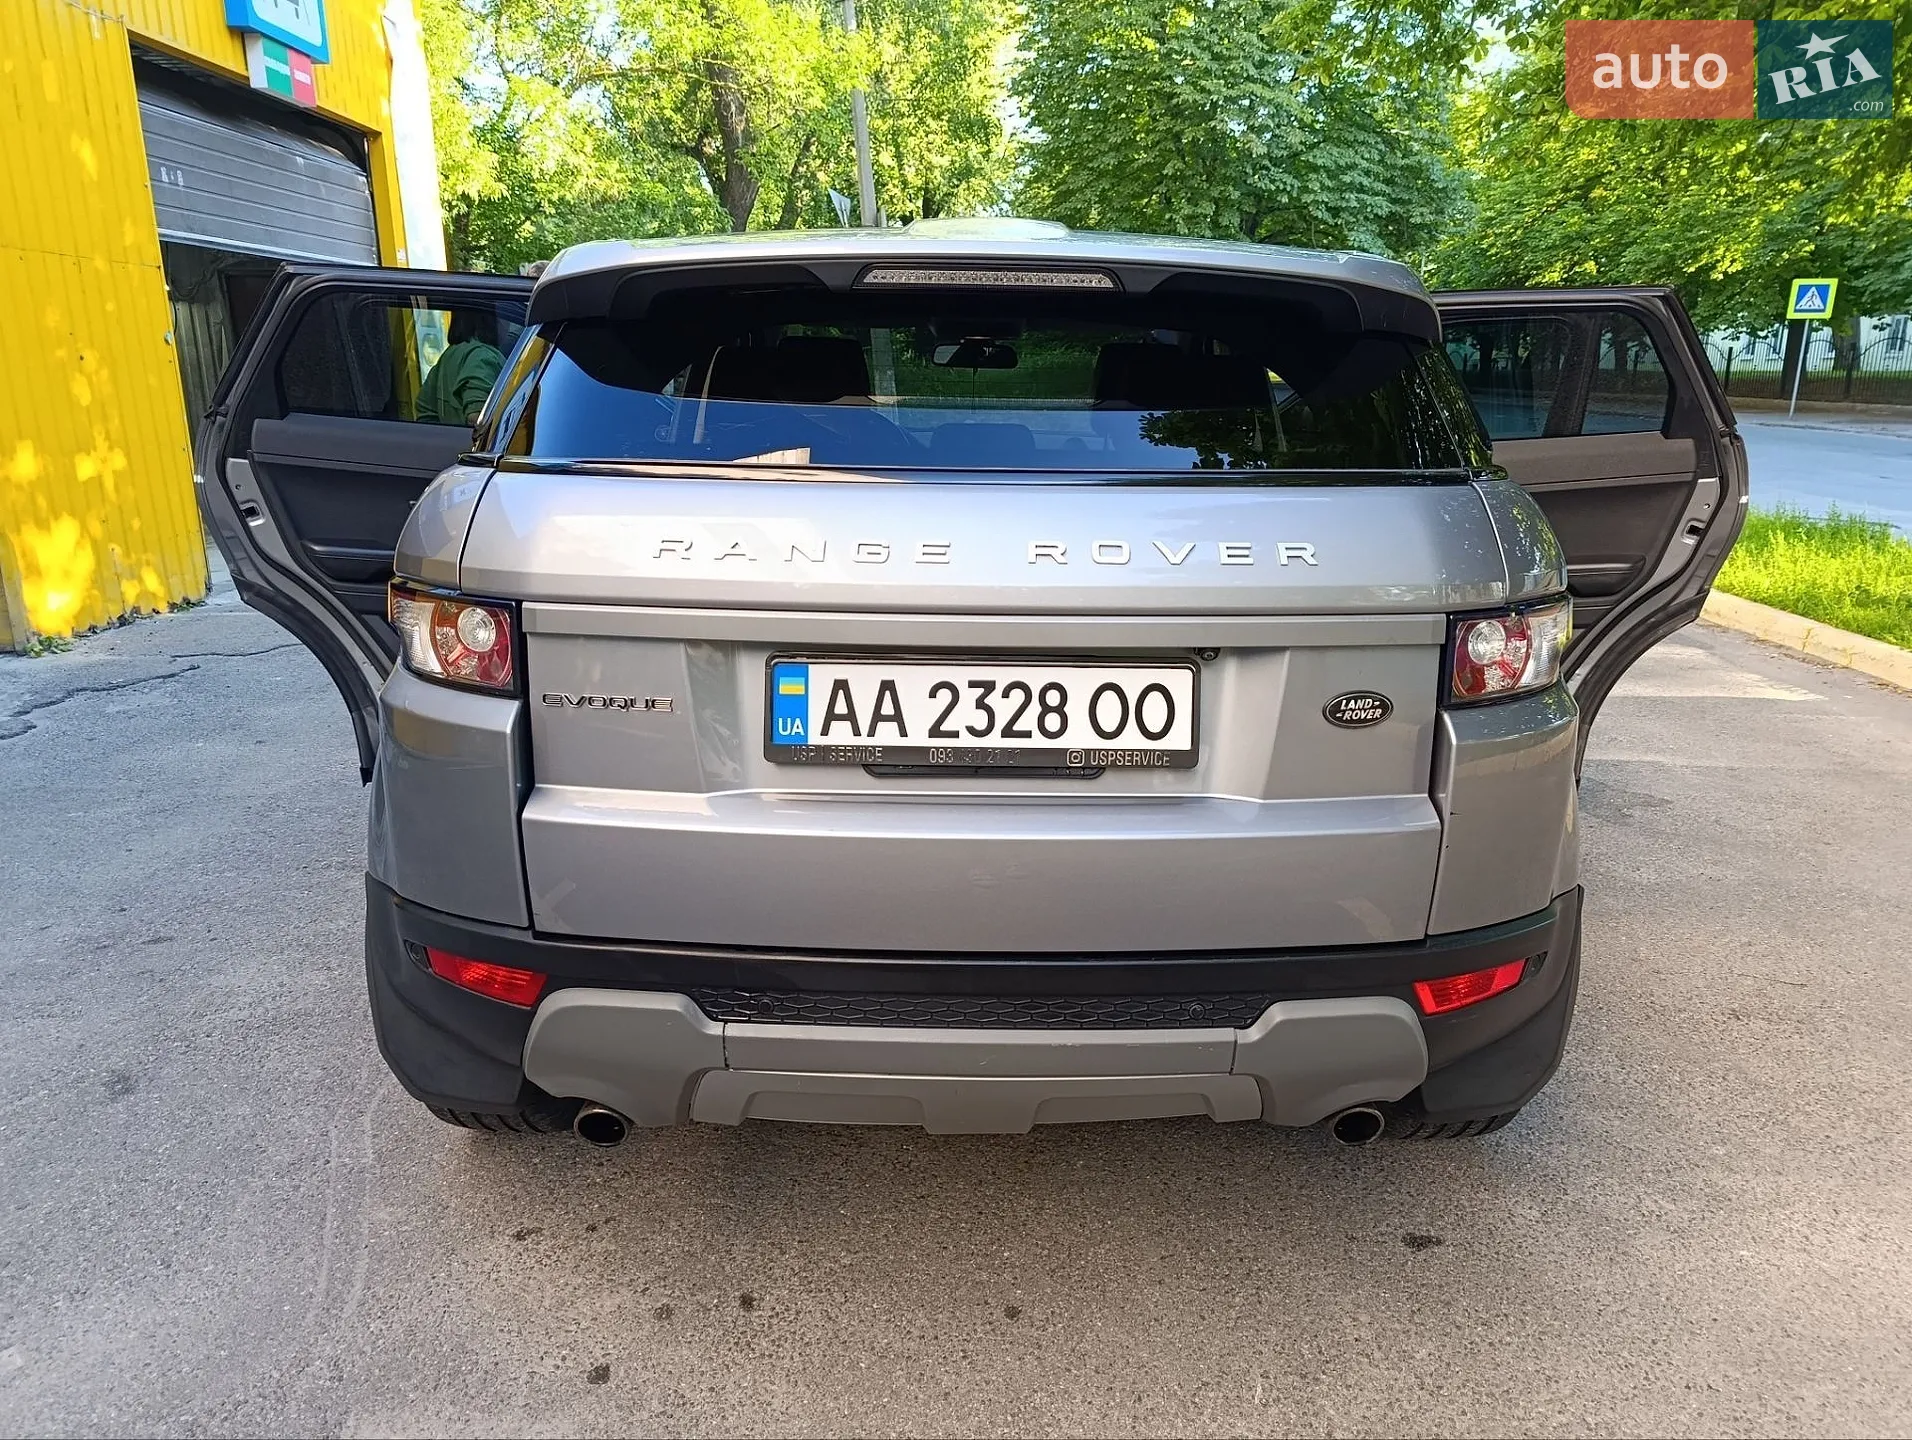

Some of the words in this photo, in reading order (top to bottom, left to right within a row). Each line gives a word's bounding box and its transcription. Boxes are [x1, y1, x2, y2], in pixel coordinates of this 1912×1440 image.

[652, 539, 952, 564] RANGE
[1027, 540, 1320, 566] ROVER
[542, 692, 674, 712] EVOQUE
[820, 678, 908, 738] AA
[927, 680, 1068, 740] 2328
[1340, 698, 1373, 710] LAND
[1342, 708, 1382, 720] ROVER
[778, 718, 805, 736] UA
[829, 746, 883, 762] SERVICE
[929, 748, 954, 763] 093
[1090, 750, 1170, 766] USPSERVICE
